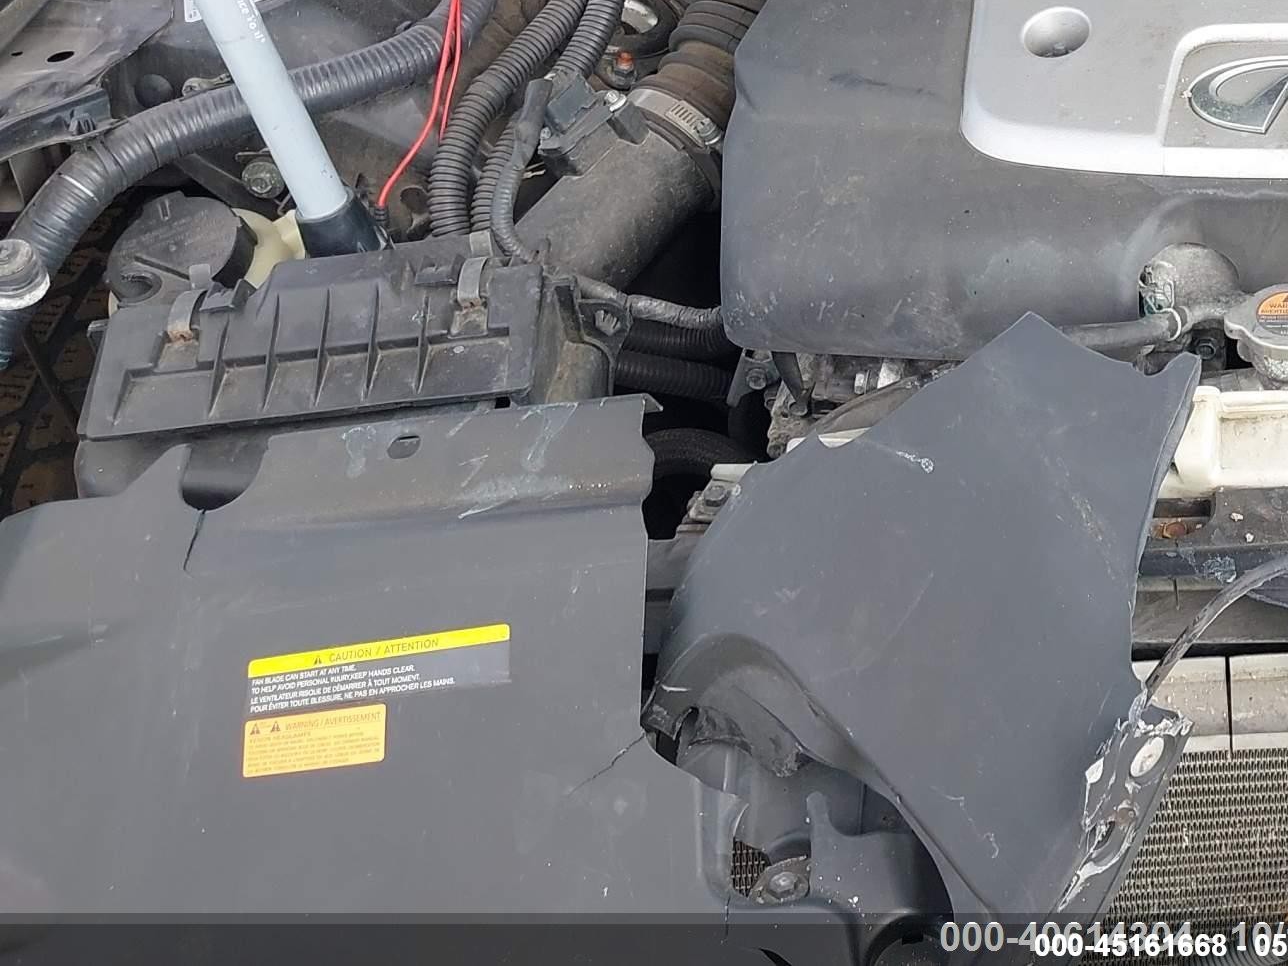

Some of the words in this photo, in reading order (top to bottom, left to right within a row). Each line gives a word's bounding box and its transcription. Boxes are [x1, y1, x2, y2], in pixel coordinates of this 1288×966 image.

[328, 648, 372, 662] CAUTION
[384, 638, 439, 654] ATTENTION
[252, 686, 260, 694] TO
[260, 684, 278, 694] HELP
[278, 682, 296, 691] AVOID
[297, 678, 330, 688] PERSONAL
[368, 668, 392, 678] HANDS
[285, 674, 298, 682] CAN
[300, 670, 319, 680] START
[328, 666, 340, 675] ANY
[374, 676, 391, 686] TOUT
[250, 704, 268, 713] POUR
[290, 698, 310, 707] TOUTE
[354, 690, 368, 698] PAS
[420, 680, 432, 690] LES
